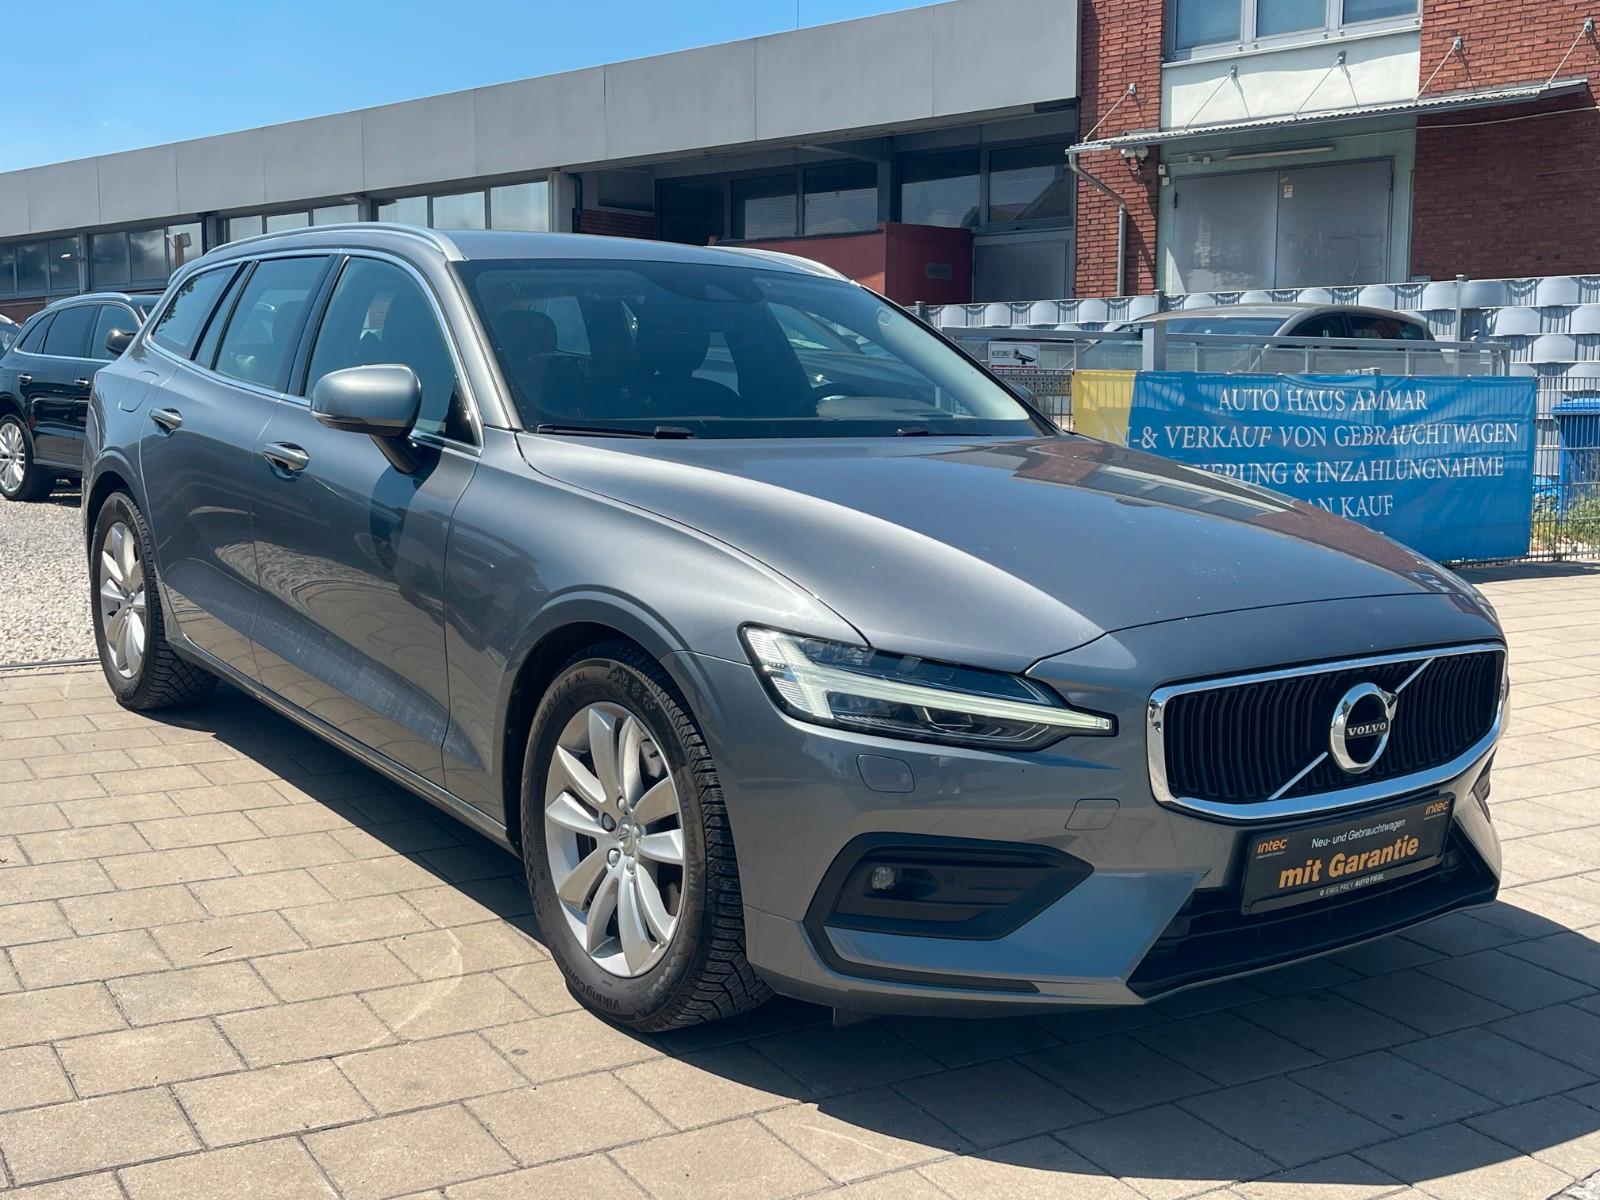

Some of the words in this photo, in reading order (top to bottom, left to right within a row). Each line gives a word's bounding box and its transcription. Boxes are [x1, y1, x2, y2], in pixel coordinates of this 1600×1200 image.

[1218, 389, 1280, 411] AUTO
[1286, 389, 1346, 411] HAUS
[1352, 388, 1429, 411] AMMAR
[1164, 425, 1273, 449] VERKAUF
[1279, 426, 1328, 448] VON
[1333, 422, 1518, 447] GEBRAUCHTWAGEN
[1294, 461, 1311, 484] &
[1316, 456, 1504, 483] INZAHLUNGNAHME
[1341, 494, 1394, 518] KAUF
[1346, 722, 1387, 737] VOLVO
[1311, 838, 1331, 848] Neu-
[1332, 832, 1347, 844] und
[1348, 819, 1406, 840] Gebrauchtwagen
[1279, 858, 1322, 888] mit
[1328, 834, 1419, 877] Garantie
